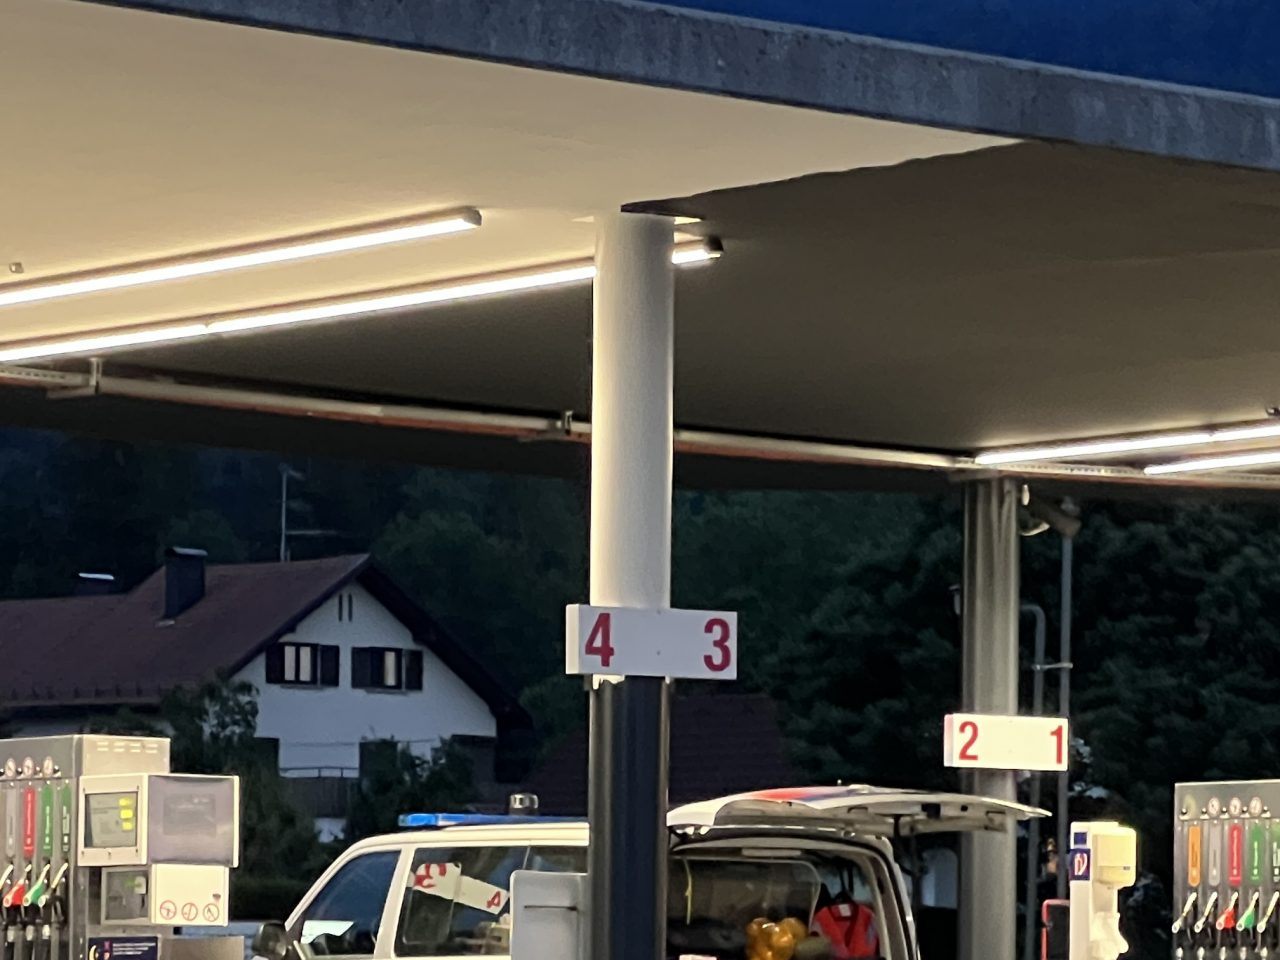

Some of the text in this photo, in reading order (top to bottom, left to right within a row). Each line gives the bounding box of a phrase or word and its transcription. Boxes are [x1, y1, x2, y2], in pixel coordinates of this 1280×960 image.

[585, 612, 614, 667] 4
[703, 617, 731, 672] 3
[958, 721, 978, 760] 2
[1050, 725, 1063, 764] 1
